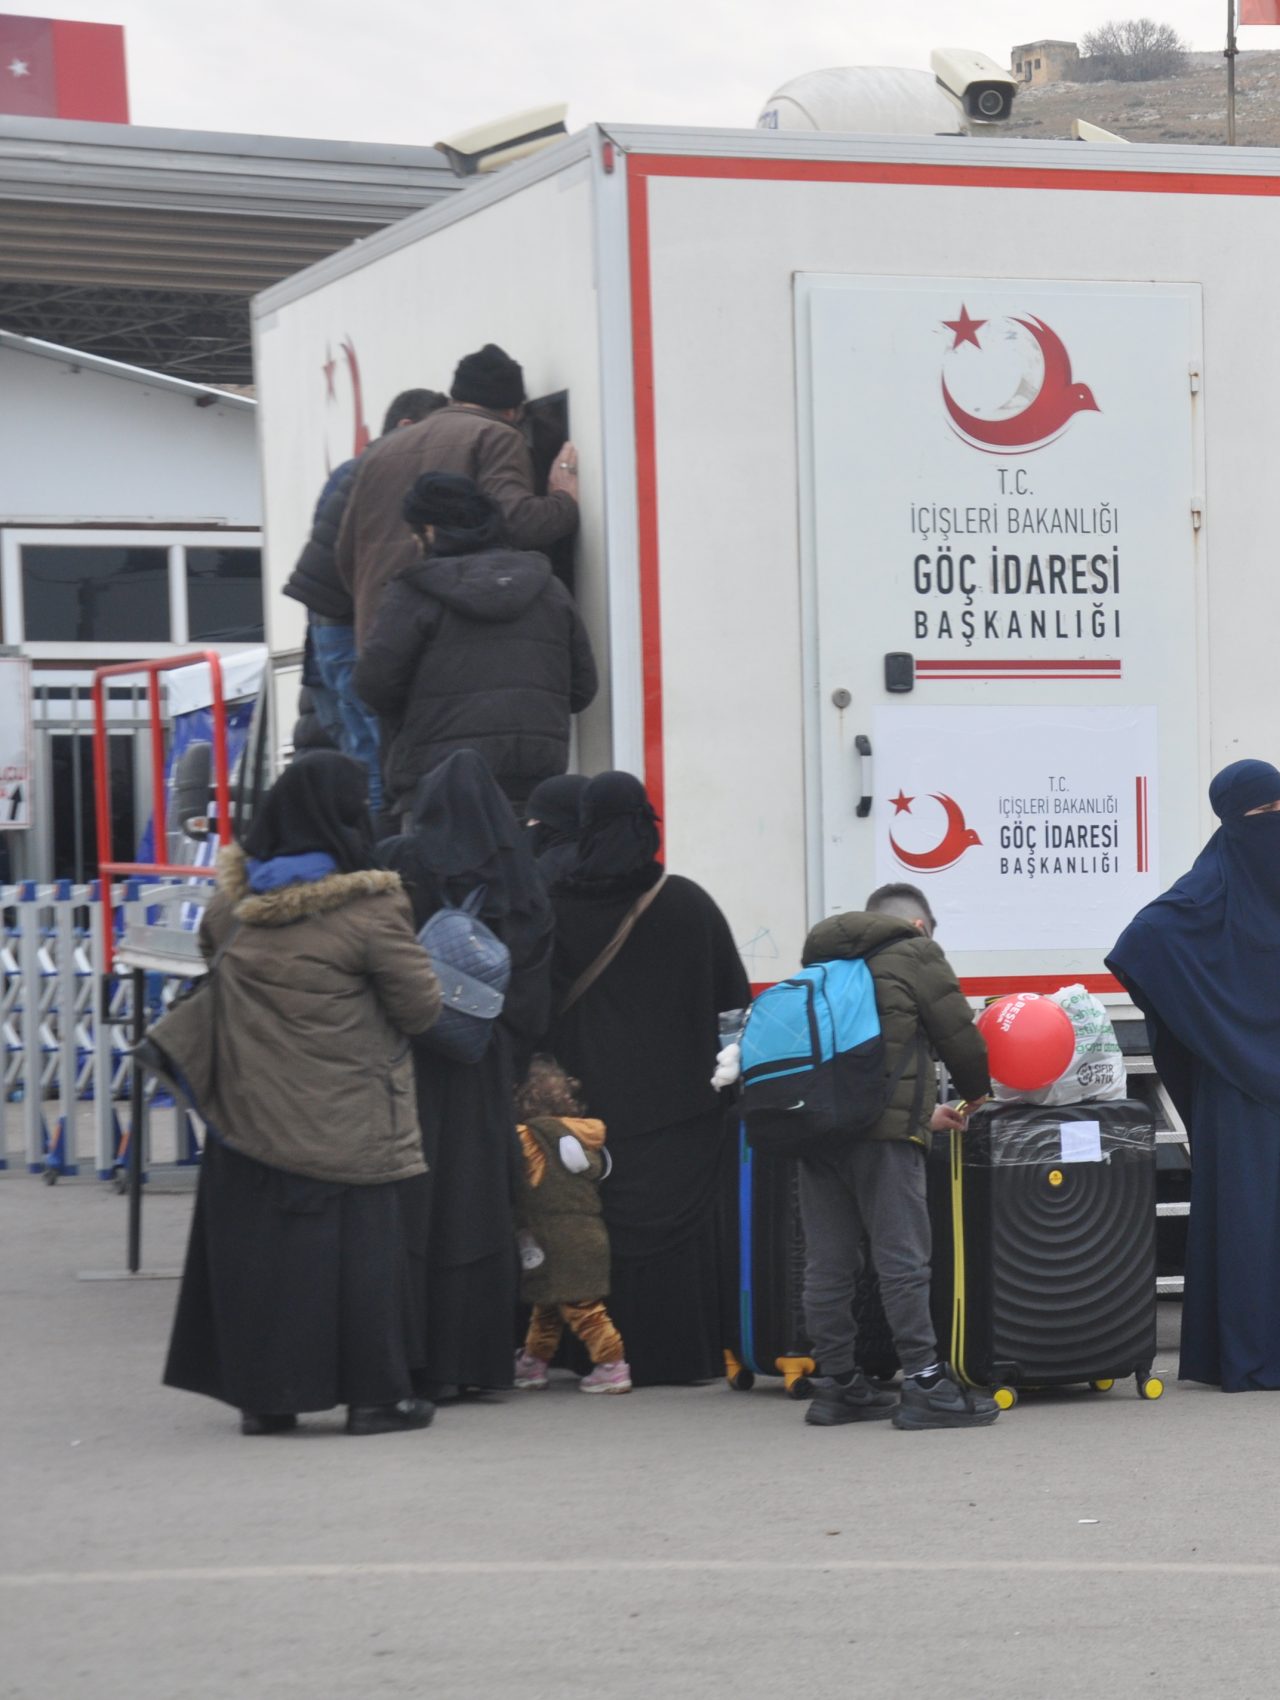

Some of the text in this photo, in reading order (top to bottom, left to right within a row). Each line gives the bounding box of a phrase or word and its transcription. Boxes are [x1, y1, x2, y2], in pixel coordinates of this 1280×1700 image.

[997, 468, 1034, 495] T.C.
[910, 502, 1119, 541] İÇİŞLERİ BAKANLIĞI
[914, 545, 1120, 606] GÖÇ İDARESİ
[914, 602, 1121, 647] BAŞKANLIĞI
[1048, 776, 1070, 792] T.C.
[999, 795, 1118, 818] İÇİŞLERİ BAKANLIĞI
[1000, 820, 1119, 855] GÖÇ İDARESİ
[1000, 852, 1119, 879] BAŞKANLIĞI
